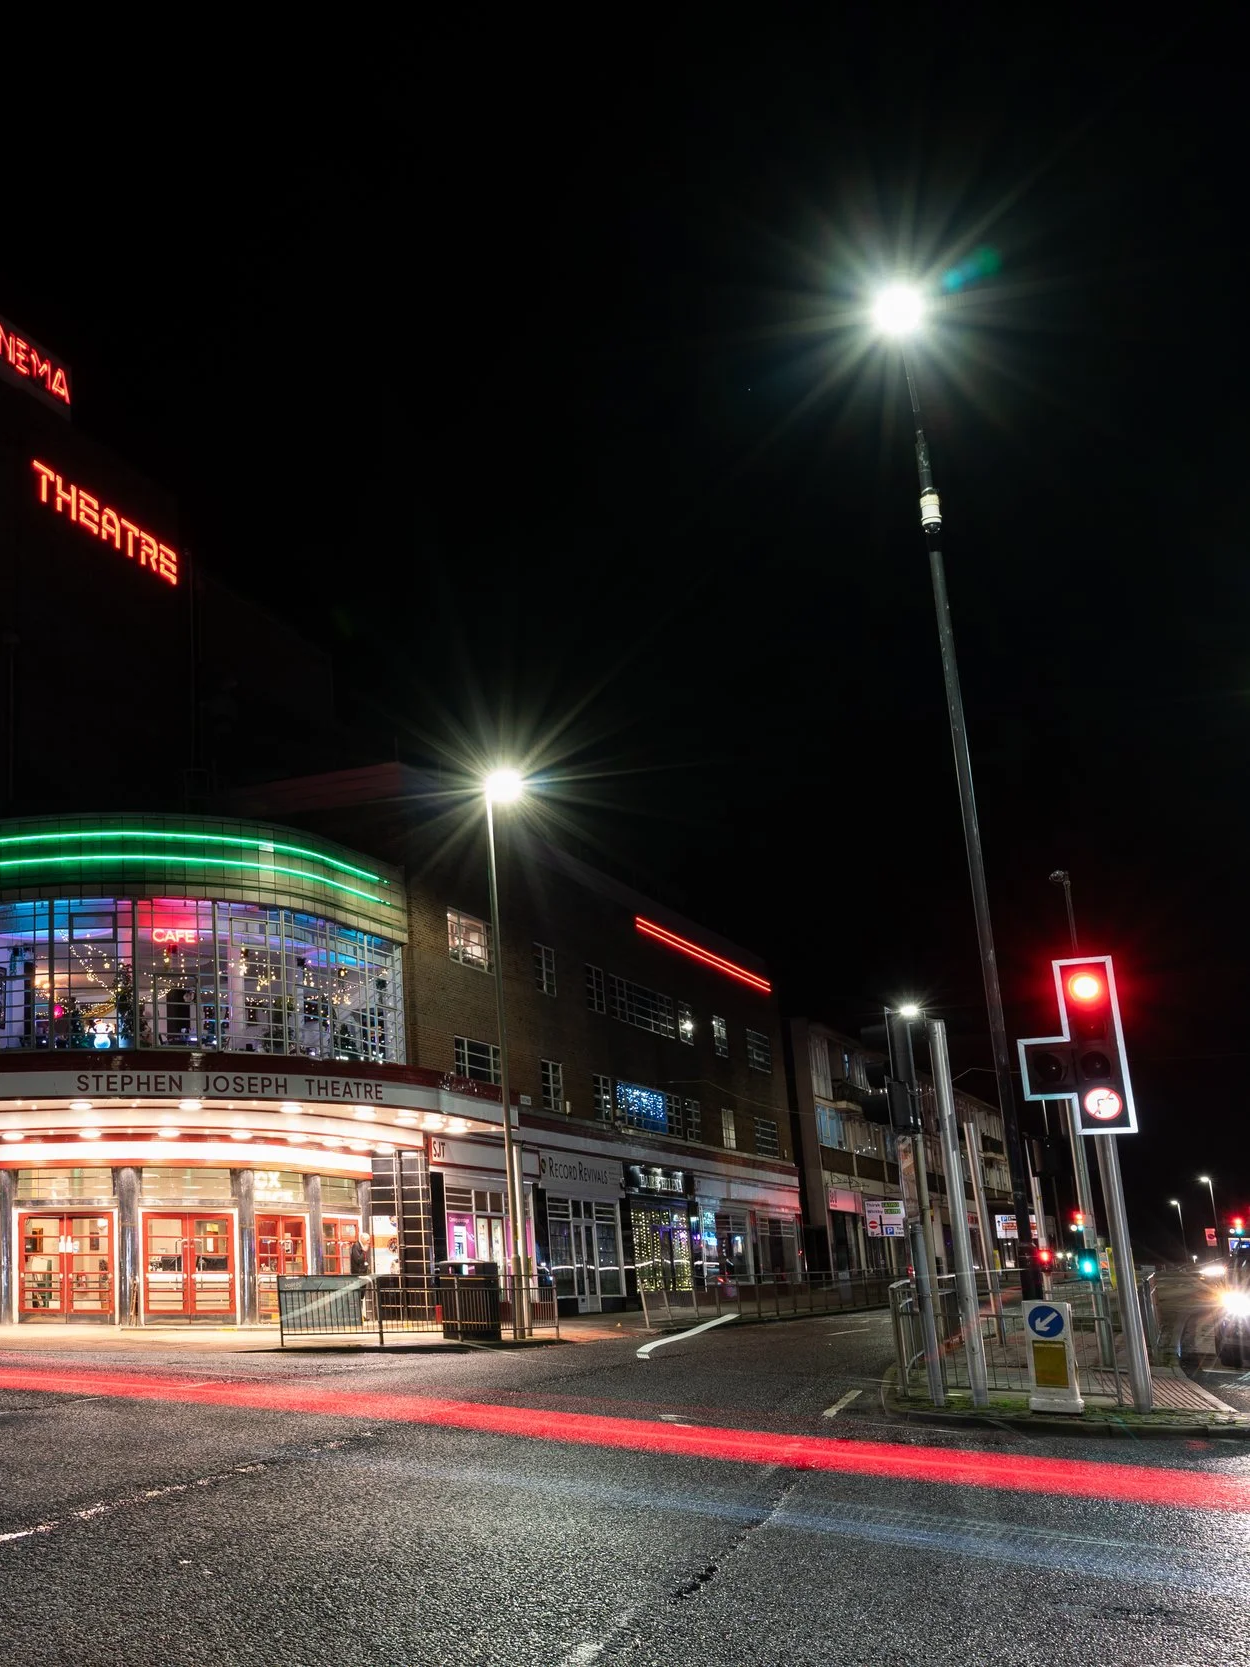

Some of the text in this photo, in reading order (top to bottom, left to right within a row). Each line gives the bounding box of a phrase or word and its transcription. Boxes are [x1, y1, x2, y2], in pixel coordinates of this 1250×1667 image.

[32, 459, 178, 586] THEATRE
[152, 928, 196, 943] CAFE
[76, 1073, 384, 1101] STEPHEN JOSEPH THEATRE
[433, 1140, 446, 1159] SJT
[253, 1170, 281, 1189] OX
